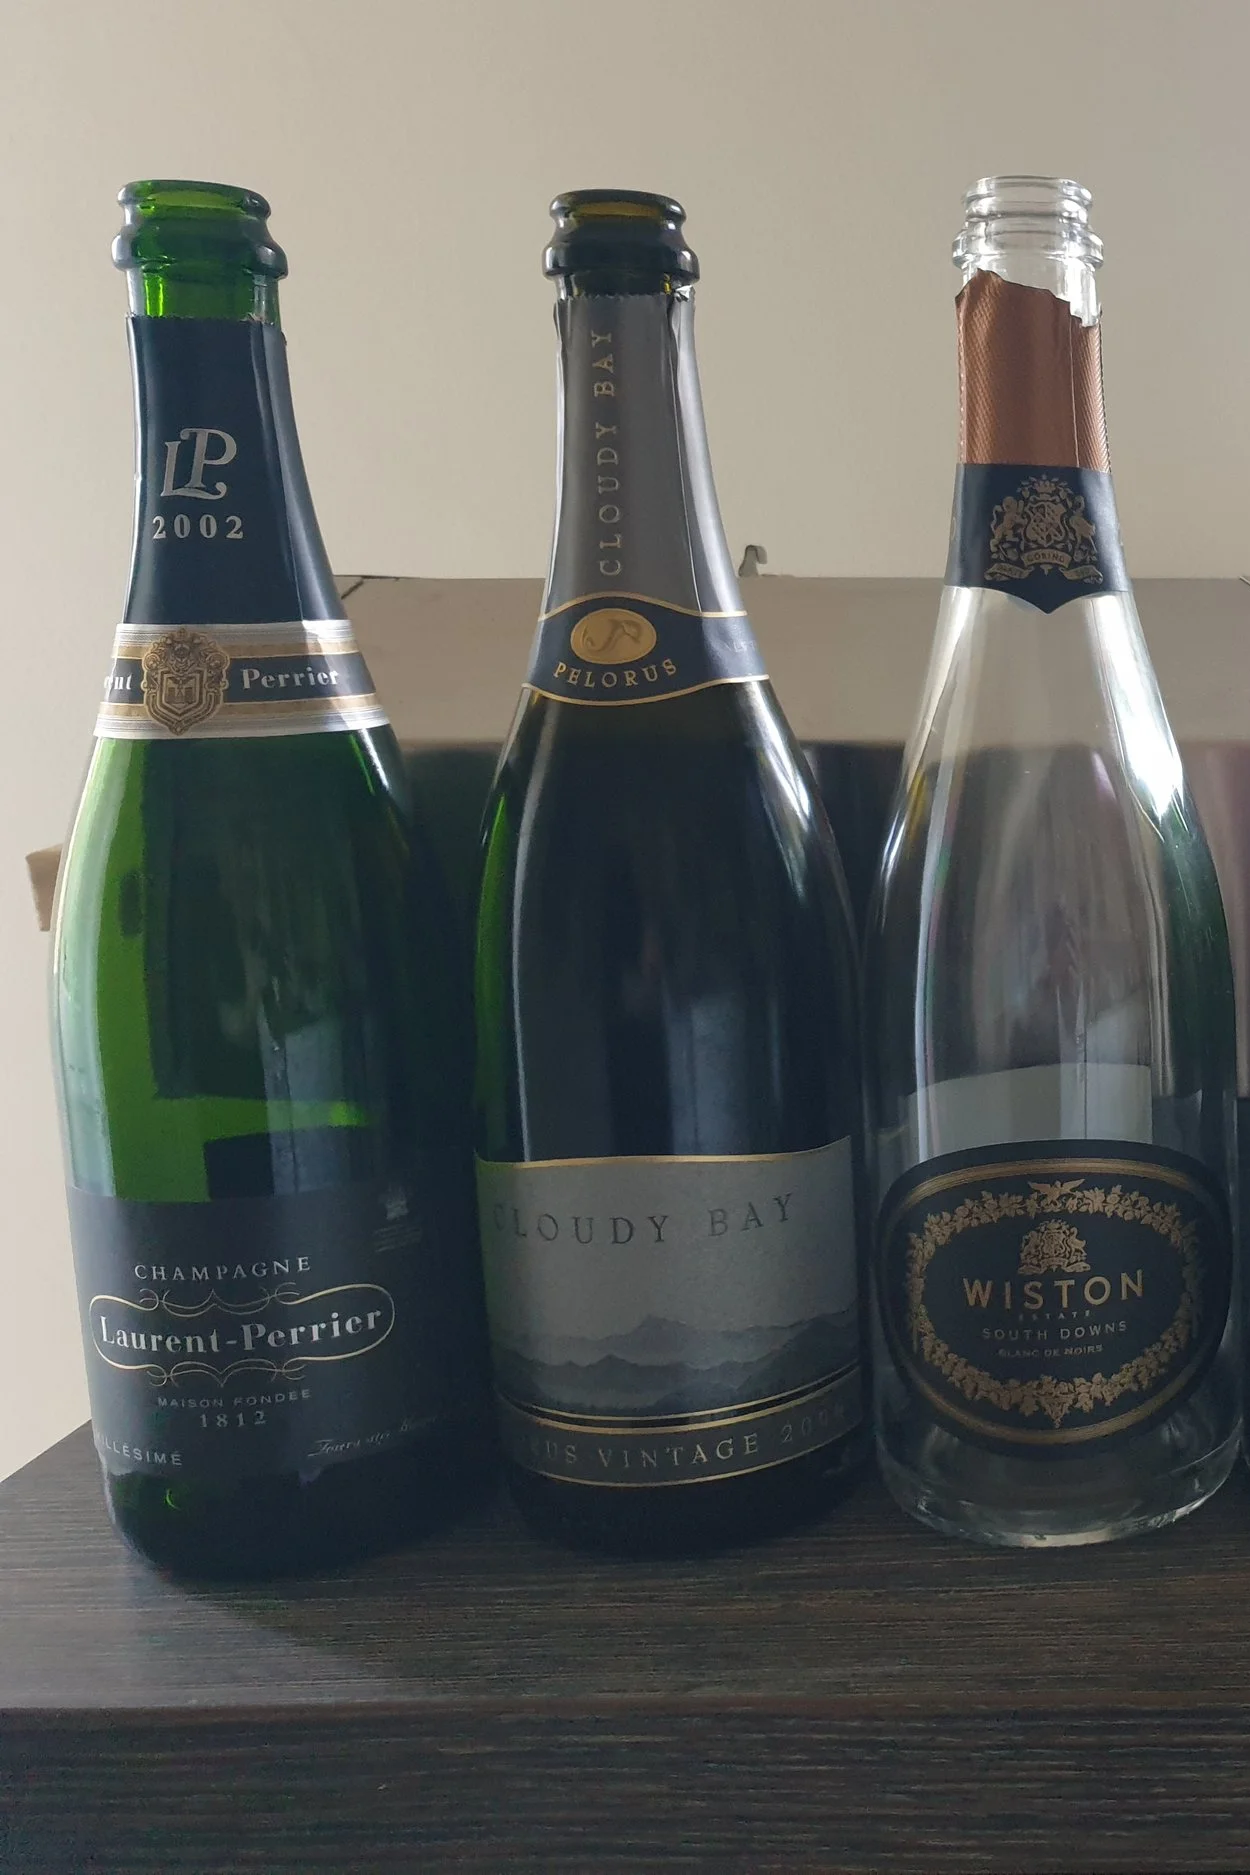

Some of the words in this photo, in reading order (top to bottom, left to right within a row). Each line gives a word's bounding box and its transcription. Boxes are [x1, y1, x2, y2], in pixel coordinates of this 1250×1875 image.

[592, 330, 616, 397] BAY
[596, 423, 621, 576] CLOUDY
[152, 514, 244, 540] 2002
[241, 667, 340, 690] Perrier
[553, 658, 677, 688] PELORUS
[494, 1202, 669, 1246] CLOUDY
[708, 1192, 794, 1238] BAY
[134, 1256, 312, 1282] CHAMPAGNE
[963, 1269, 1145, 1311] WISTON
[99, 1308, 384, 1355] Laurent-Perrier
[982, 1327, 1048, 1341] SOUTH
[1060, 1319, 1128, 1340] DOWNS
[997, 1347, 1039, 1359] BLANC
[1043, 1347, 1061, 1358] DE
[1063, 1343, 1104, 1356] NOIRS
[158, 1396, 224, 1409] MAISON
[199, 1410, 267, 1428] 1812
[598, 1431, 759, 1468] VINTAGE
